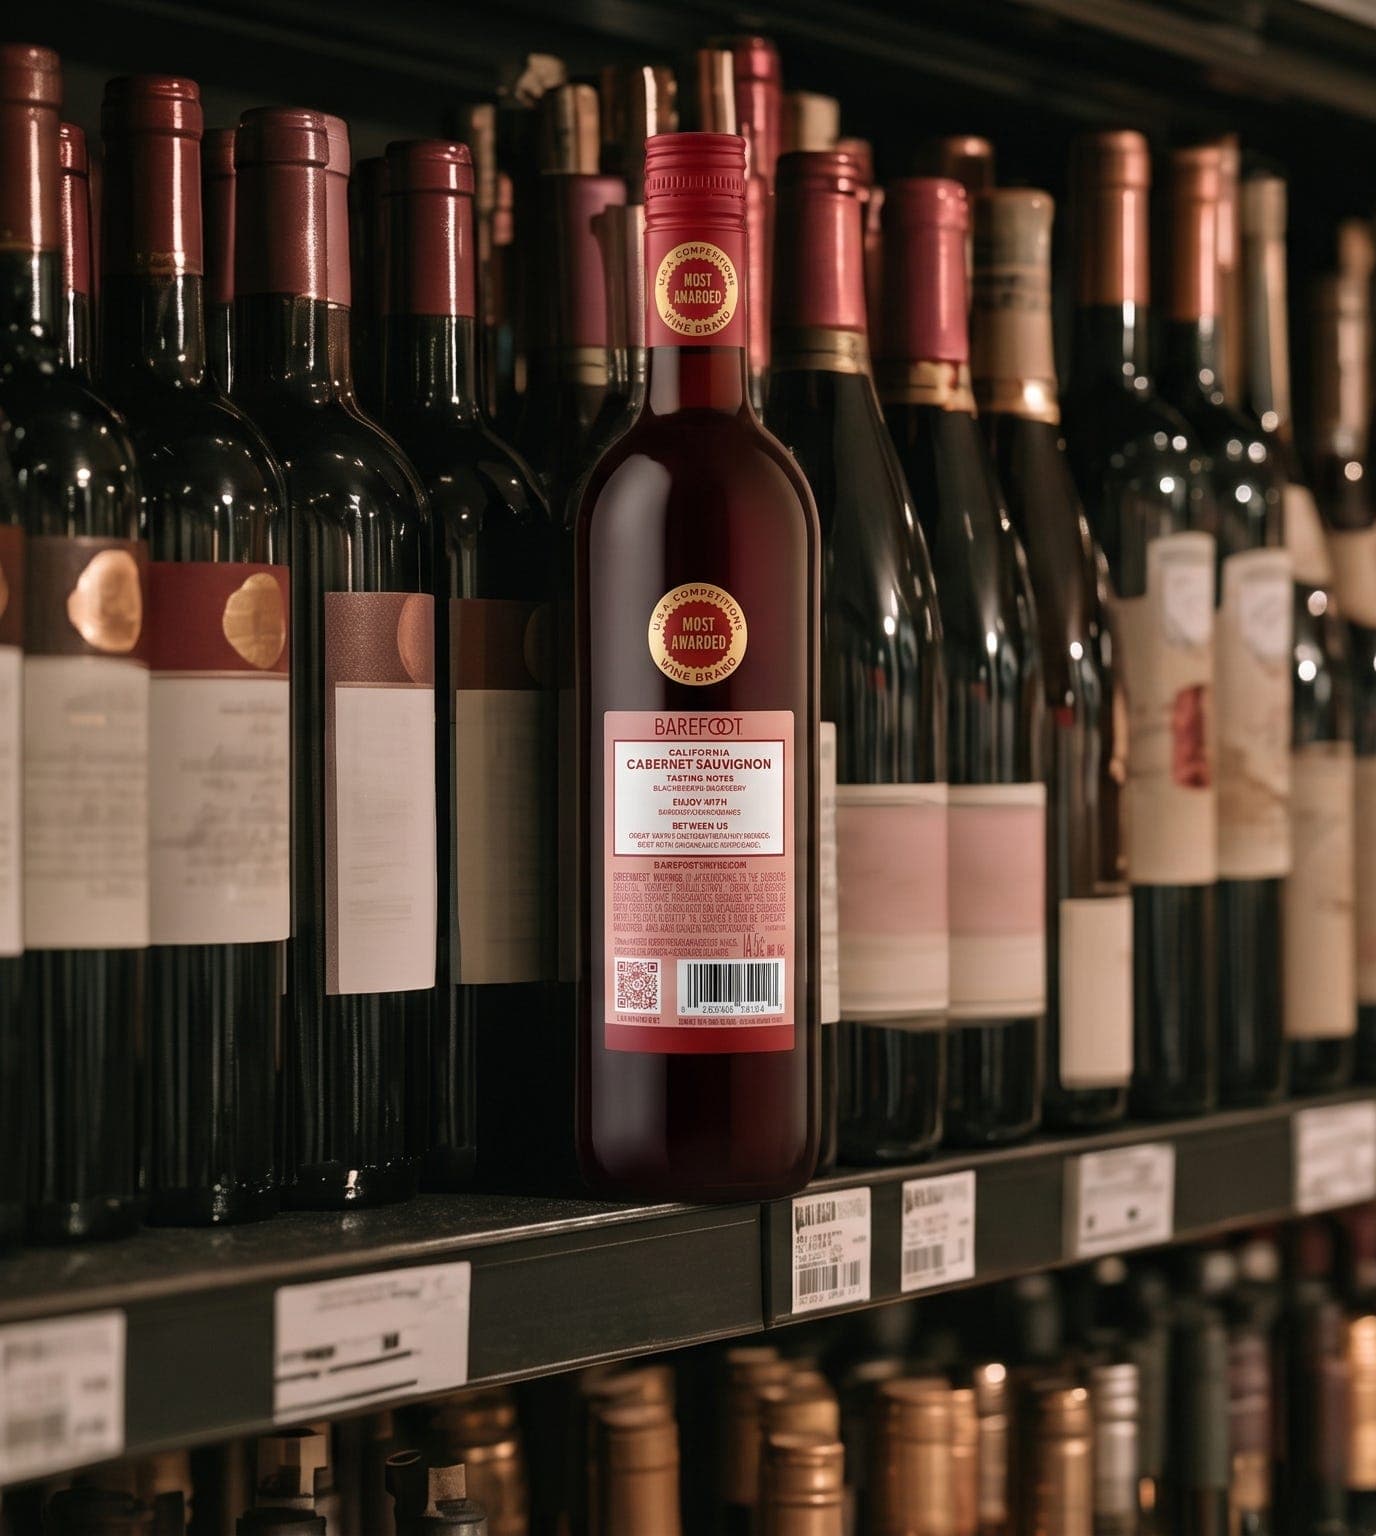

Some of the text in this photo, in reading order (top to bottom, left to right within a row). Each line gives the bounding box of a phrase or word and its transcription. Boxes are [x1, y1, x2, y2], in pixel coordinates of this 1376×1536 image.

[684, 273, 712, 287] MOST
[682, 617, 715, 632] MOST
[672, 635, 726, 650] AWARDED
[655, 717, 743, 736] BAREFOOT
[627, 759, 771, 769] CABERNET SAUVIGNON
[672, 822, 728, 830] BETWEEN US
